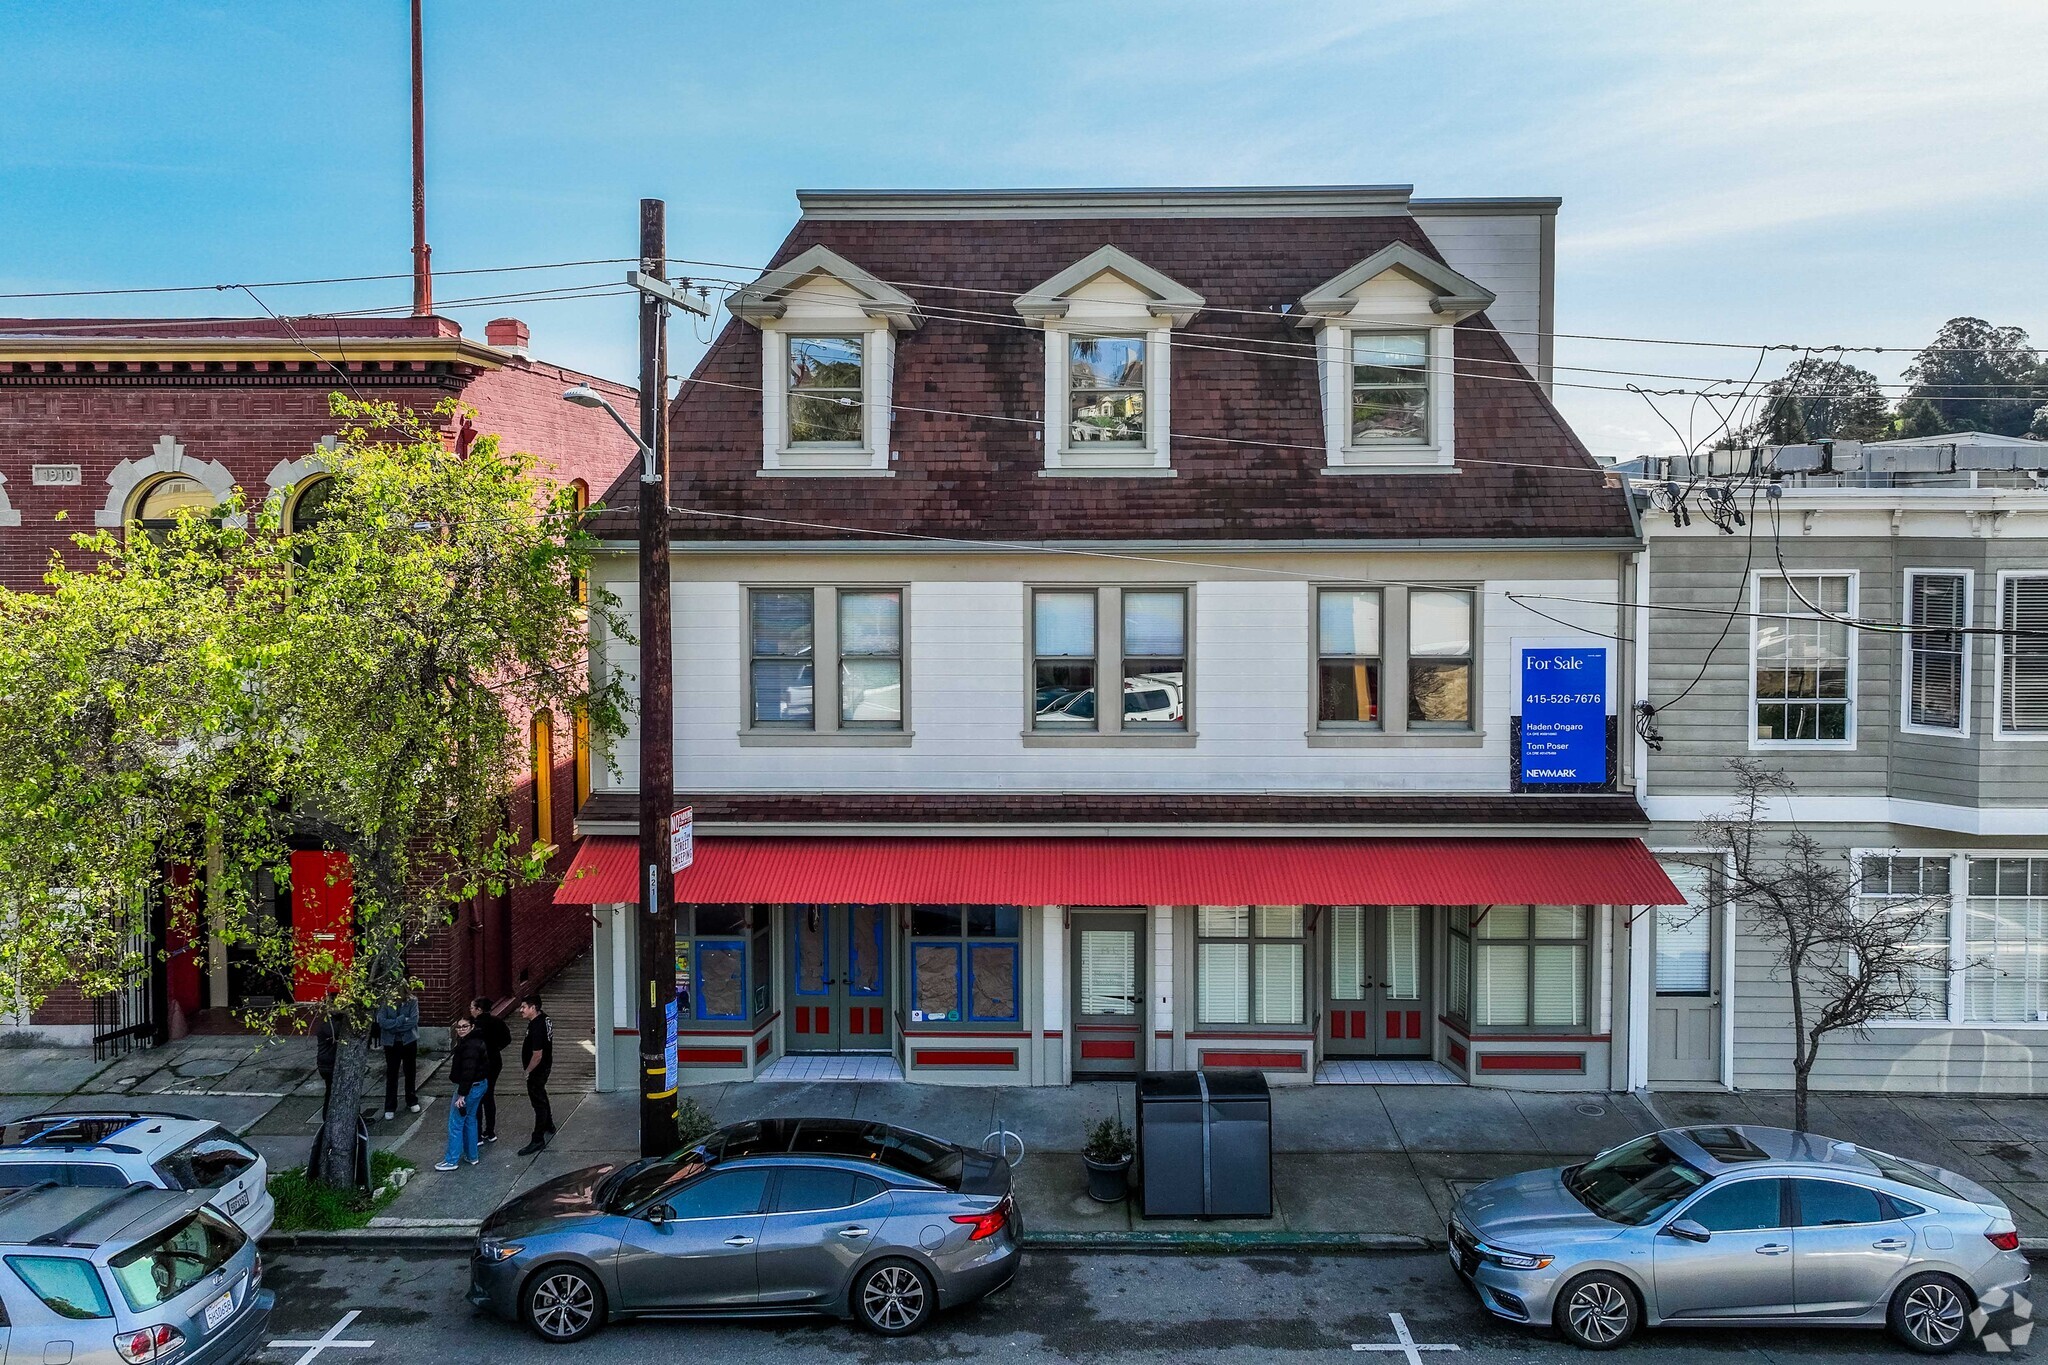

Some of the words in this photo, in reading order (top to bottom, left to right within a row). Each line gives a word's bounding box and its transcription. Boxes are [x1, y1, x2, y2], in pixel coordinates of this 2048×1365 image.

[44, 468, 73, 482] 1910
[1526, 655, 1552, 670] For
[1553, 655, 1583, 670] Sale
[1526, 693, 1601, 704] 415-526-7676
[1526, 723, 1552, 731] Haden
[1553, 722, 1584, 732] Ongaro
[1526, 742, 1545, 750] Tom
[1546, 742, 1569, 750] Poser
[1526, 768, 1577, 778] NEWMARK
[672, 813, 679, 832] NO
[674, 838, 690, 854] STREET
[672, 848, 692, 867] SWEEPING
